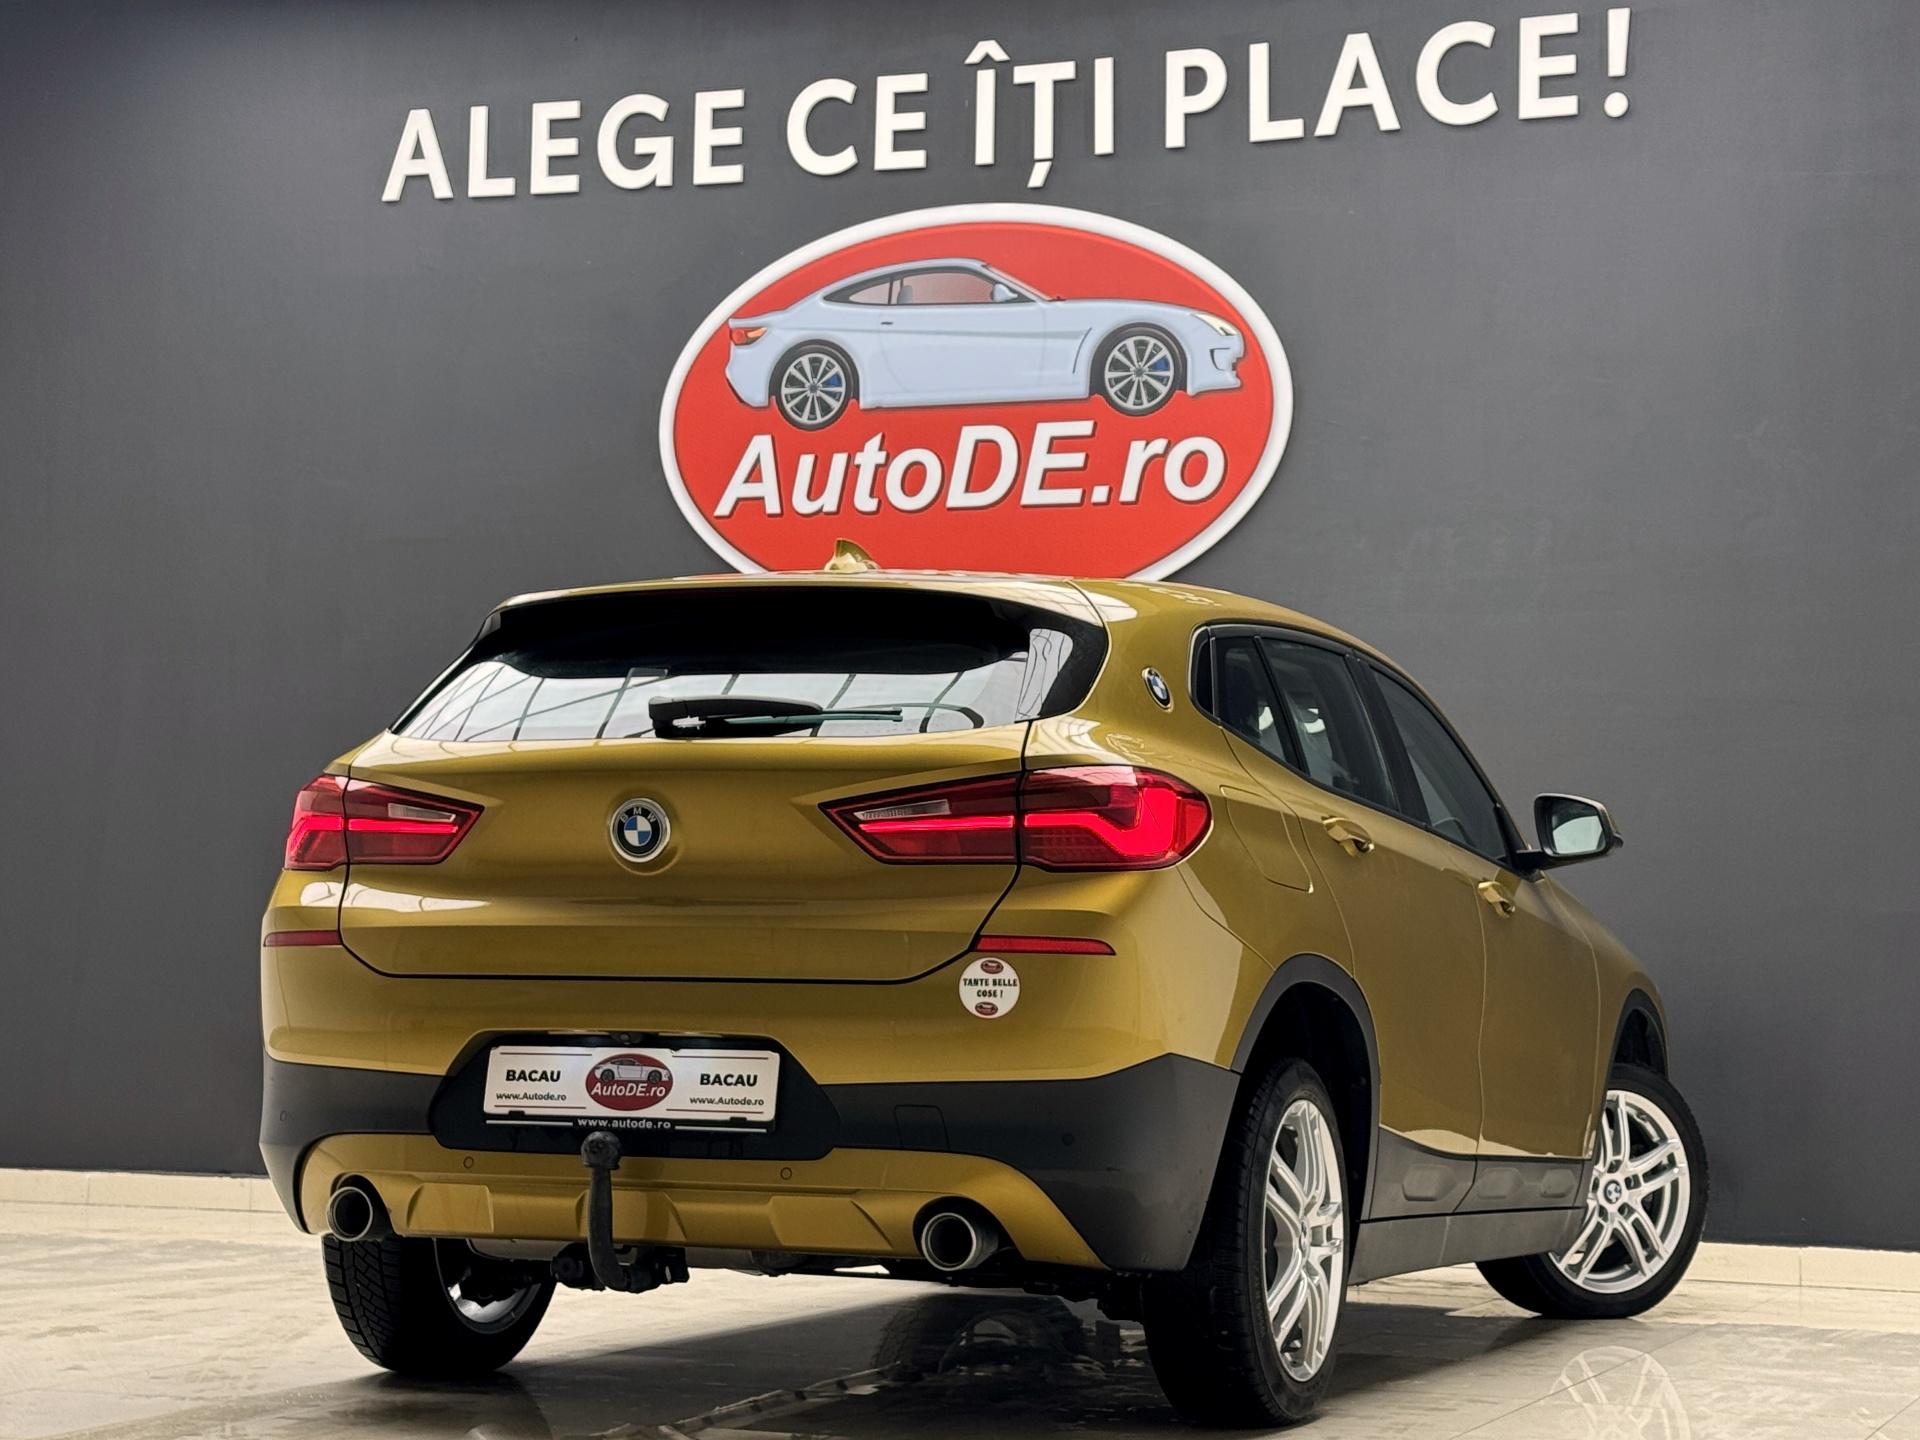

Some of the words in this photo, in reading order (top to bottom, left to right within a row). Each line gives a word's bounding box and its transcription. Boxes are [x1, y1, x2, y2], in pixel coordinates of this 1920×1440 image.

[381, 88, 745, 203] ALEGE
[786, 73, 929, 176] CE
[1164, 7, 1631, 149] PLACE!
[713, 419, 1226, 518] AutoDE.ro
[620, 807, 656, 822] BMW
[963, 978, 989, 986] TANTE
[992, 978, 1017, 986] BELLE
[505, 1069, 561, 1083] BACAU
[700, 1073, 758, 1087] BACAU
[496, 1092, 567, 1101] www.Autode.ro
[591, 1082, 666, 1097] AutoDE.ro
[689, 1096, 765, 1106] www.Autode.ro
[577, 1118, 671, 1129] www.autode.ro
